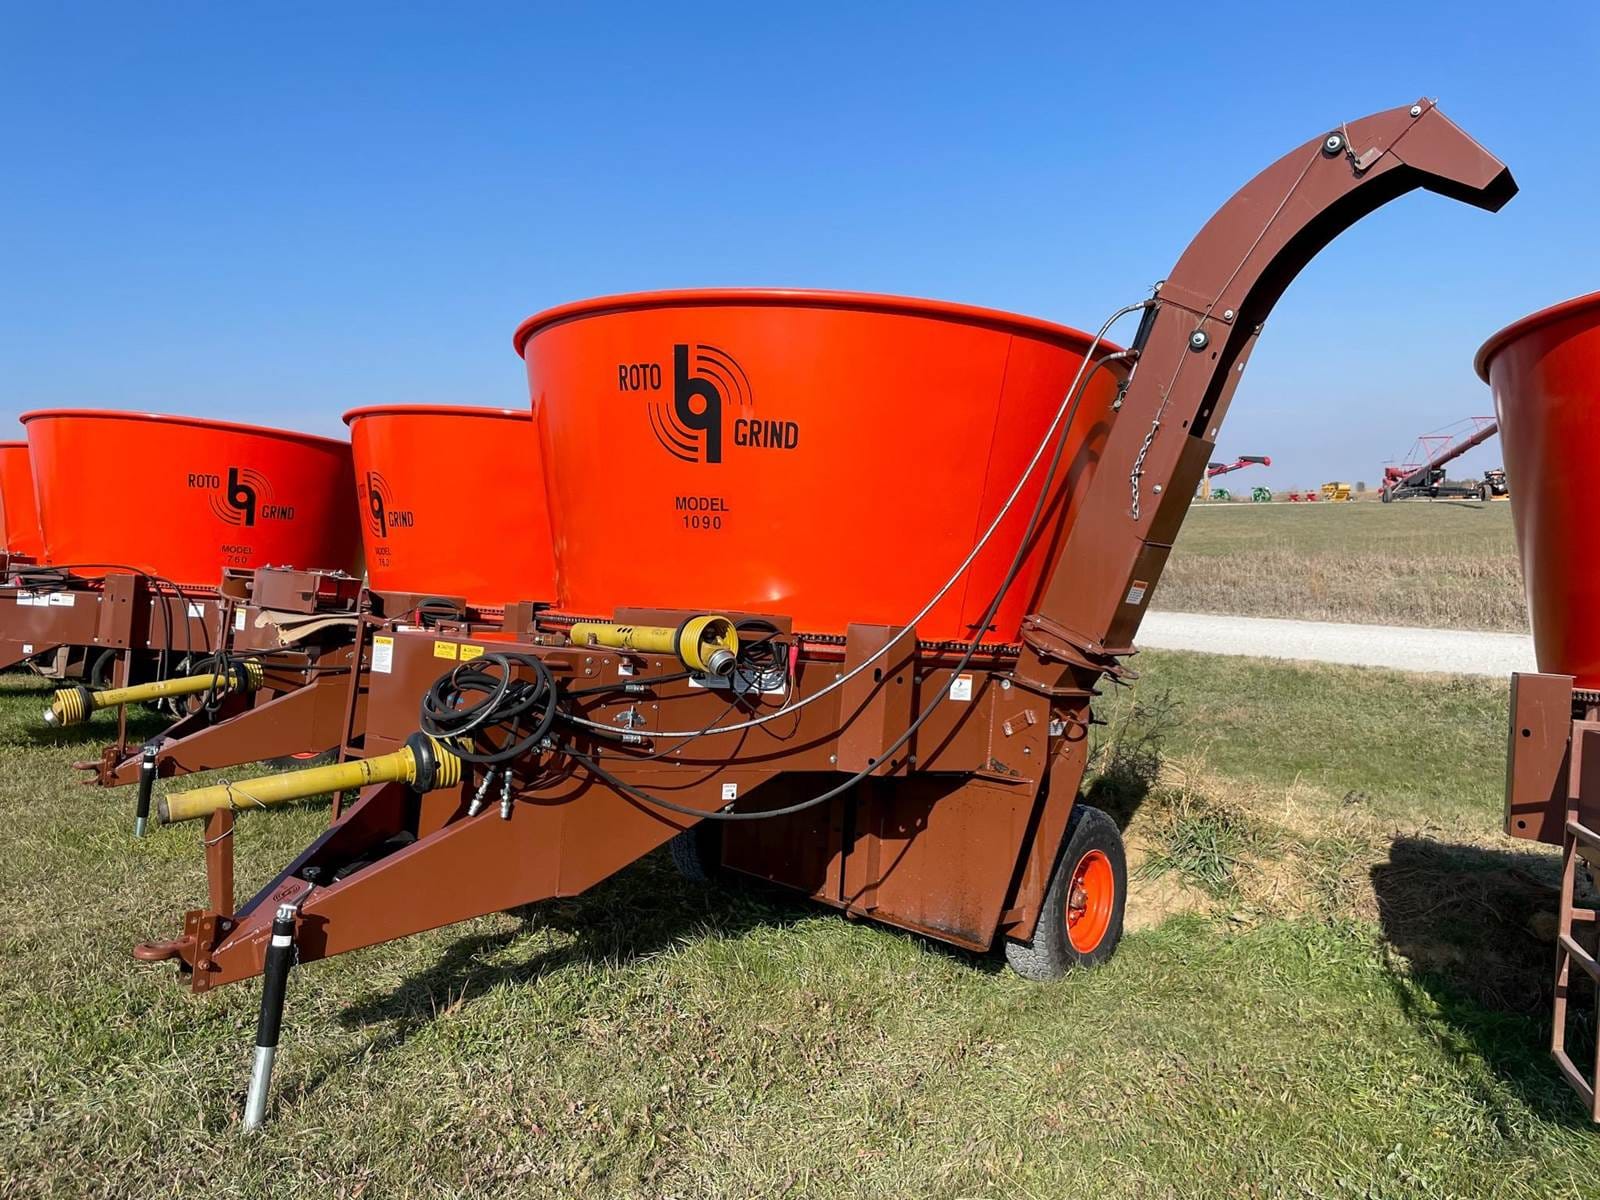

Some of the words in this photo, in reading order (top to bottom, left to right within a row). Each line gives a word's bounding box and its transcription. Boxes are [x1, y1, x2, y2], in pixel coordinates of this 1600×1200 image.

[618, 363, 662, 392] ROTO
[734, 418, 799, 450] GRIND
[188, 473, 220, 489] ROTO
[675, 496, 729, 512] MODEL
[262, 505, 295, 520] GRIND
[388, 511, 414, 527] GRIND
[682, 515, 722, 530] 1090
[222, 545, 253, 554] MODEL
